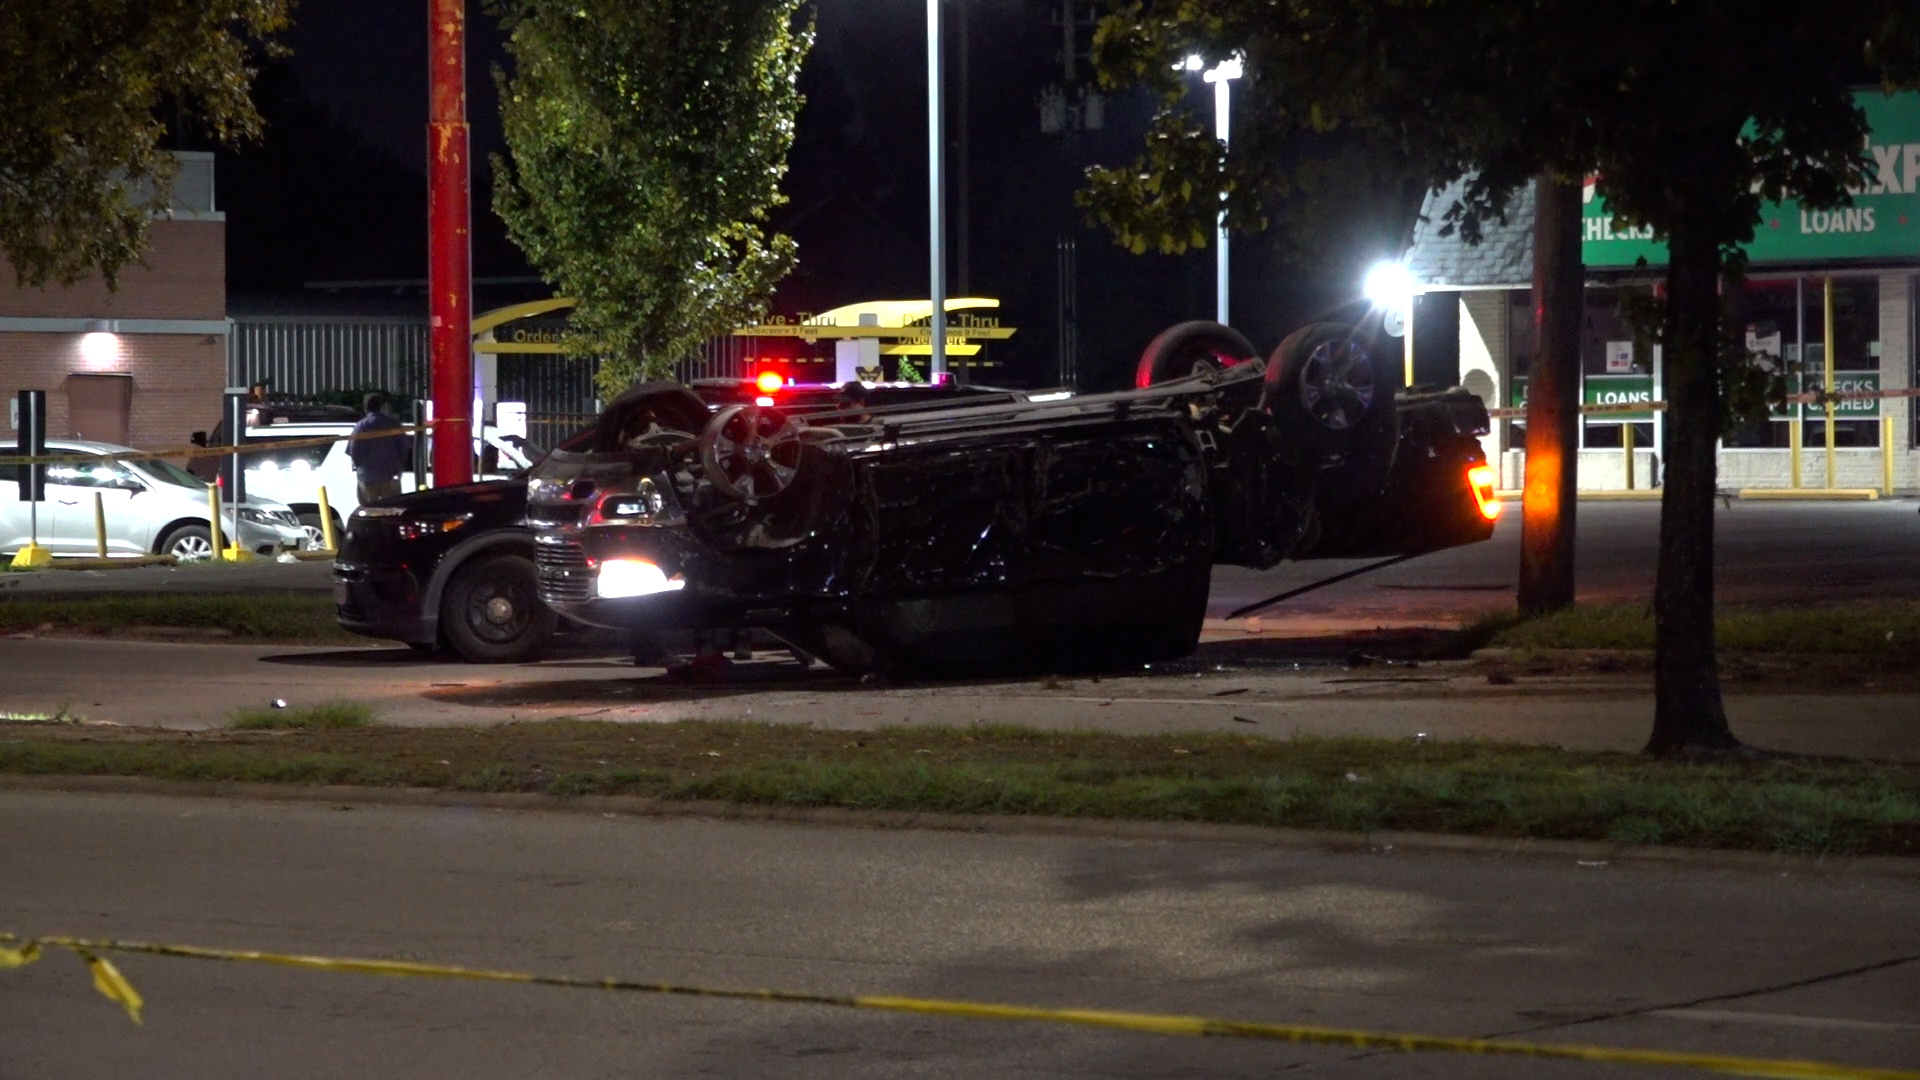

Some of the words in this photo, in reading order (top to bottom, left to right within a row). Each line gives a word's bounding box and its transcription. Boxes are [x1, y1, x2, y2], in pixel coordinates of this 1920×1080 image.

[1801, 207, 1875, 234] LOANS
[514, 329, 559, 342] Order
[1596, 391, 1650, 405] LOANS
